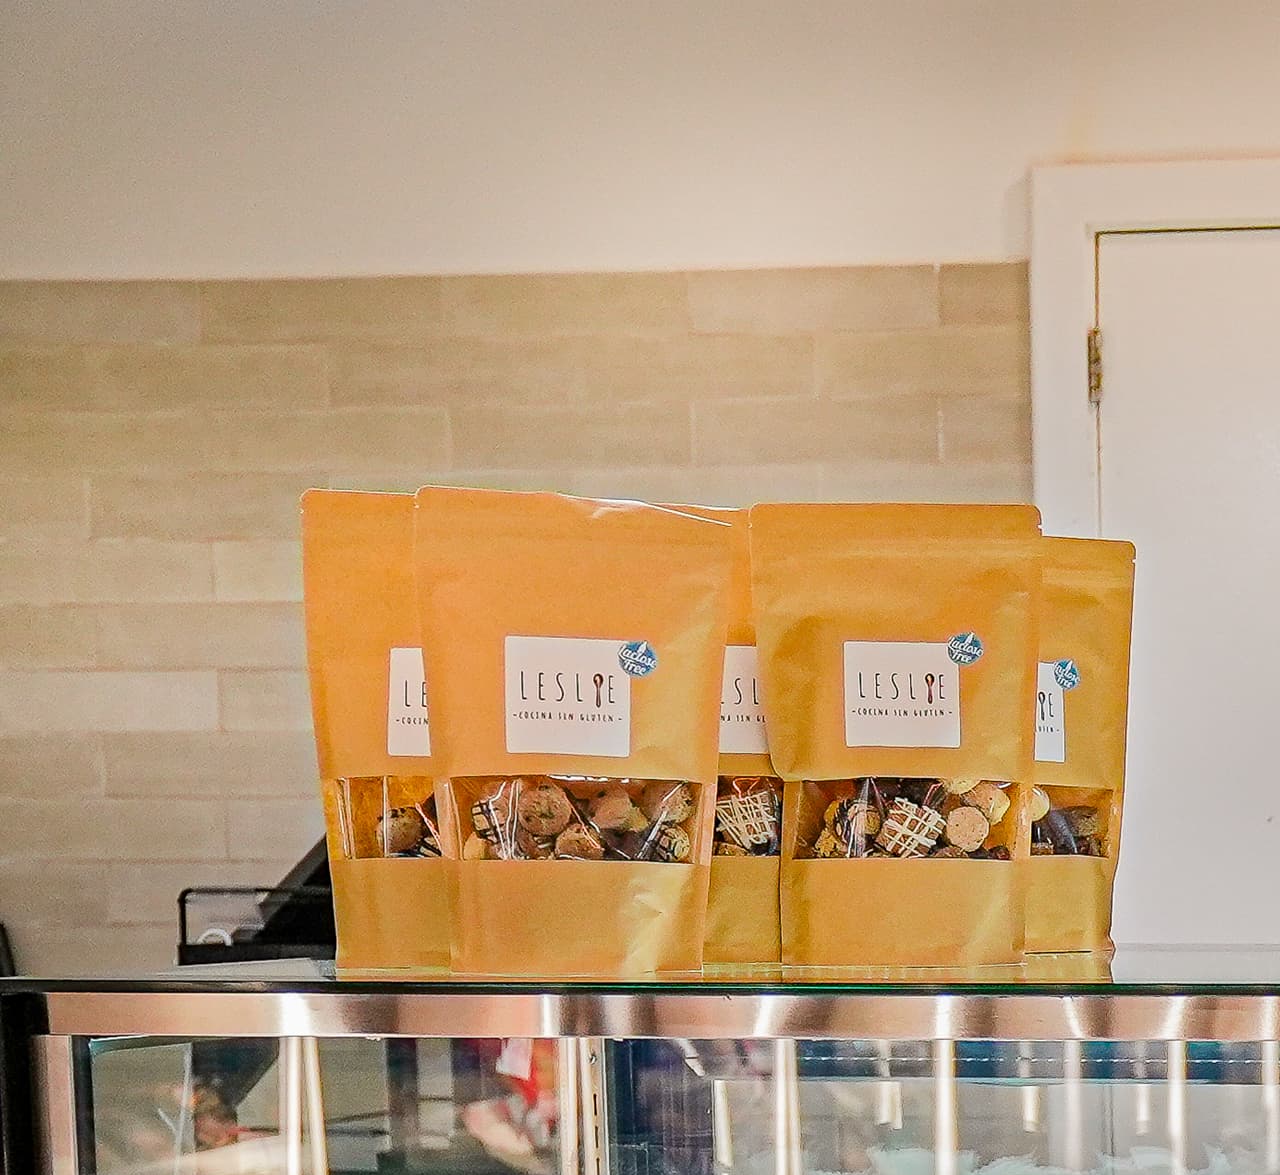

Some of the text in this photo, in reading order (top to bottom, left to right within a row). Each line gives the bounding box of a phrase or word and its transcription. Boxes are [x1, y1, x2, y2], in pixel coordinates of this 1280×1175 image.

[619, 644, 657, 669] Lactose
[520, 670, 615, 708] LESLIE
[858, 671, 945, 704] LESLIE
